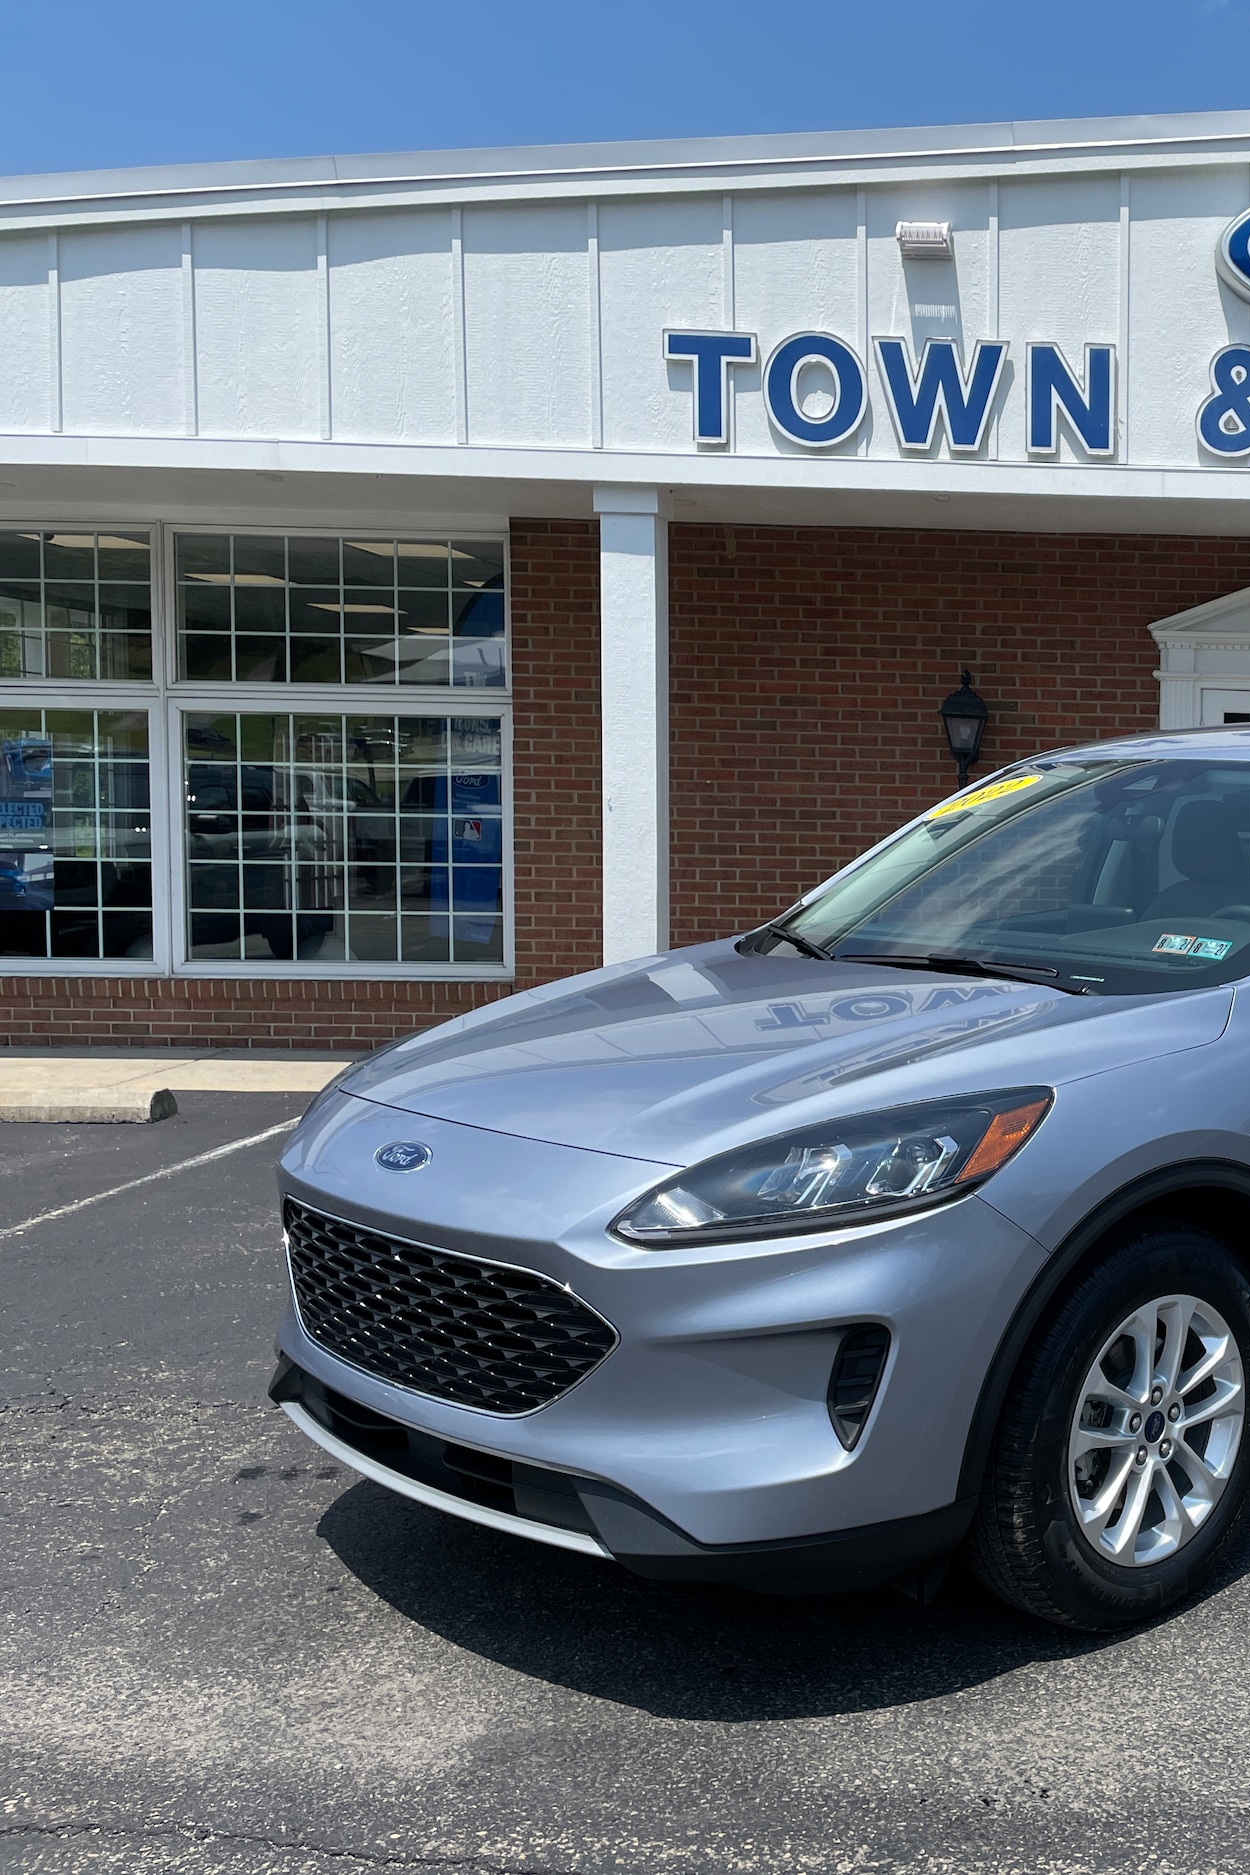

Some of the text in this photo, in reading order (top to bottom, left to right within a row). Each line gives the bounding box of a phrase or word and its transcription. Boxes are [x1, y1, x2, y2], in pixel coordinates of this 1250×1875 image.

[662, 328, 1117, 457] TOWN
[0, 802, 48, 815] LECTED.
[382, 1144, 419, 1166] Ford
